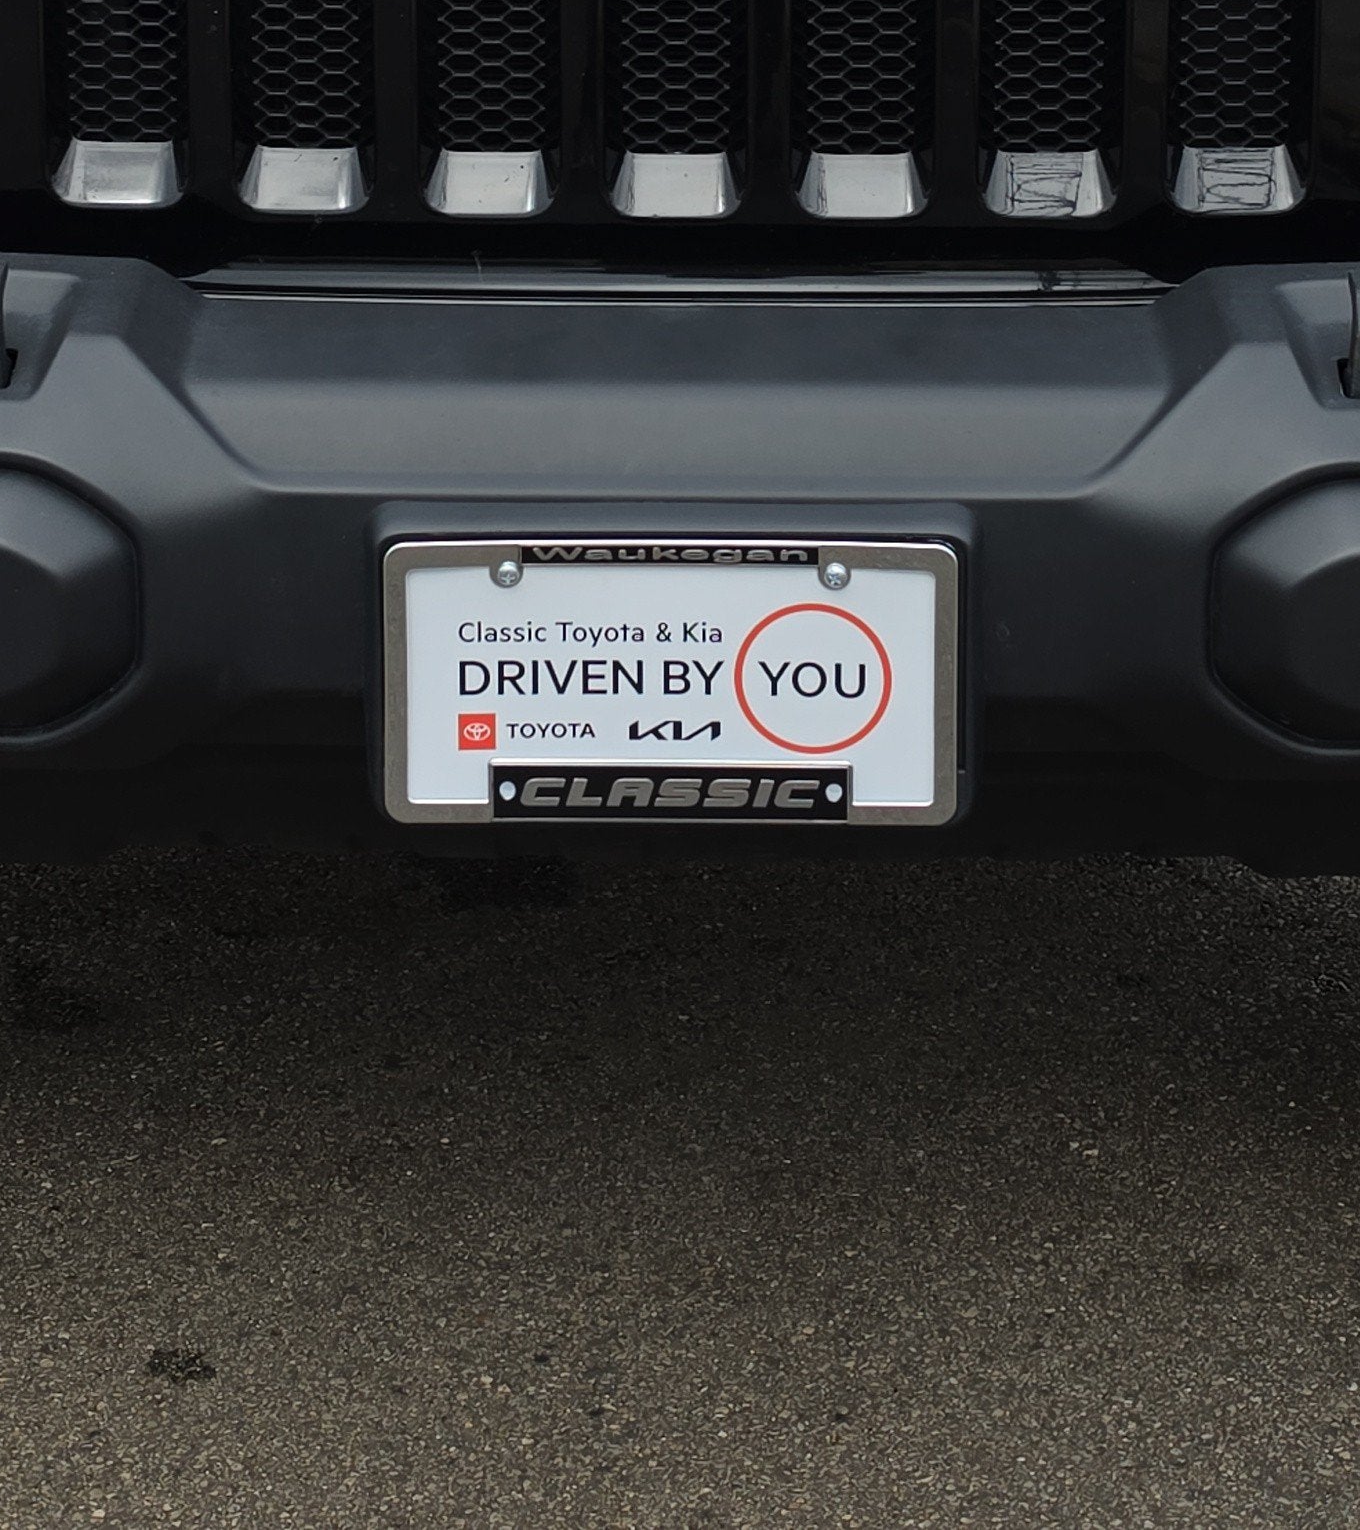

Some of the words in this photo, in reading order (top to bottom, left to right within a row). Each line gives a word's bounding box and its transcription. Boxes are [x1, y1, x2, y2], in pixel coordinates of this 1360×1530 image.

[532, 546, 808, 563] Waukegan
[458, 621, 547, 643] Classic
[555, 621, 645, 647] Toyota
[656, 622, 672, 643] &
[683, 621, 723, 643] Kia
[458, 660, 644, 695] DRIVEN
[663, 660, 724, 695] BY
[758, 661, 867, 698] YOU
[506, 723, 596, 739] TOYOTA
[520, 778, 821, 808] CLASSIC
